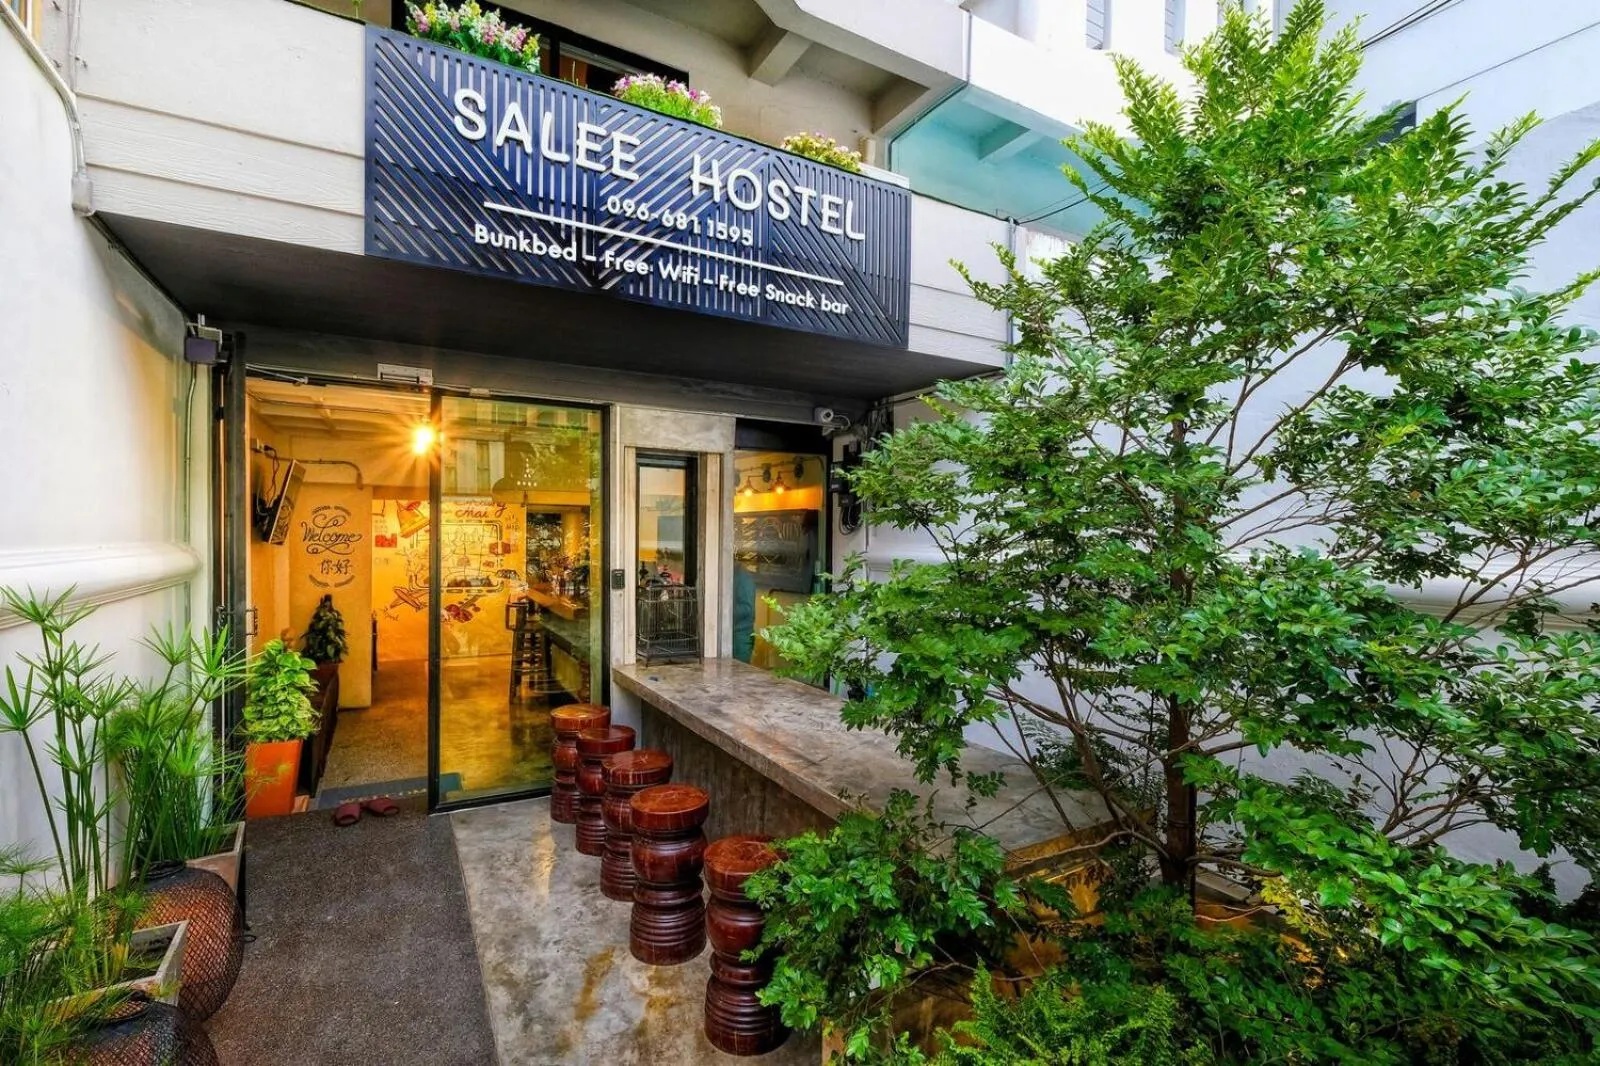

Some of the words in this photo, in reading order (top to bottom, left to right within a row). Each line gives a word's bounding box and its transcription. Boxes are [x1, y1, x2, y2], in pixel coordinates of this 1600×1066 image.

[453, 88, 641, 181] SALEE
[690, 153, 866, 241] HOSTEL
[706, 217, 754, 247] 1595
[474, 223, 578, 262] Bunkbed
[604, 250, 650, 275] Free
[658, 257, 700, 286] Wifi
[719, 273, 760, 297] Free
[765, 283, 816, 309] Snack
[821, 294, 849, 315] bar
[301, 514, 363, 549] Welcome
[320, 558, 353, 576] 你好
